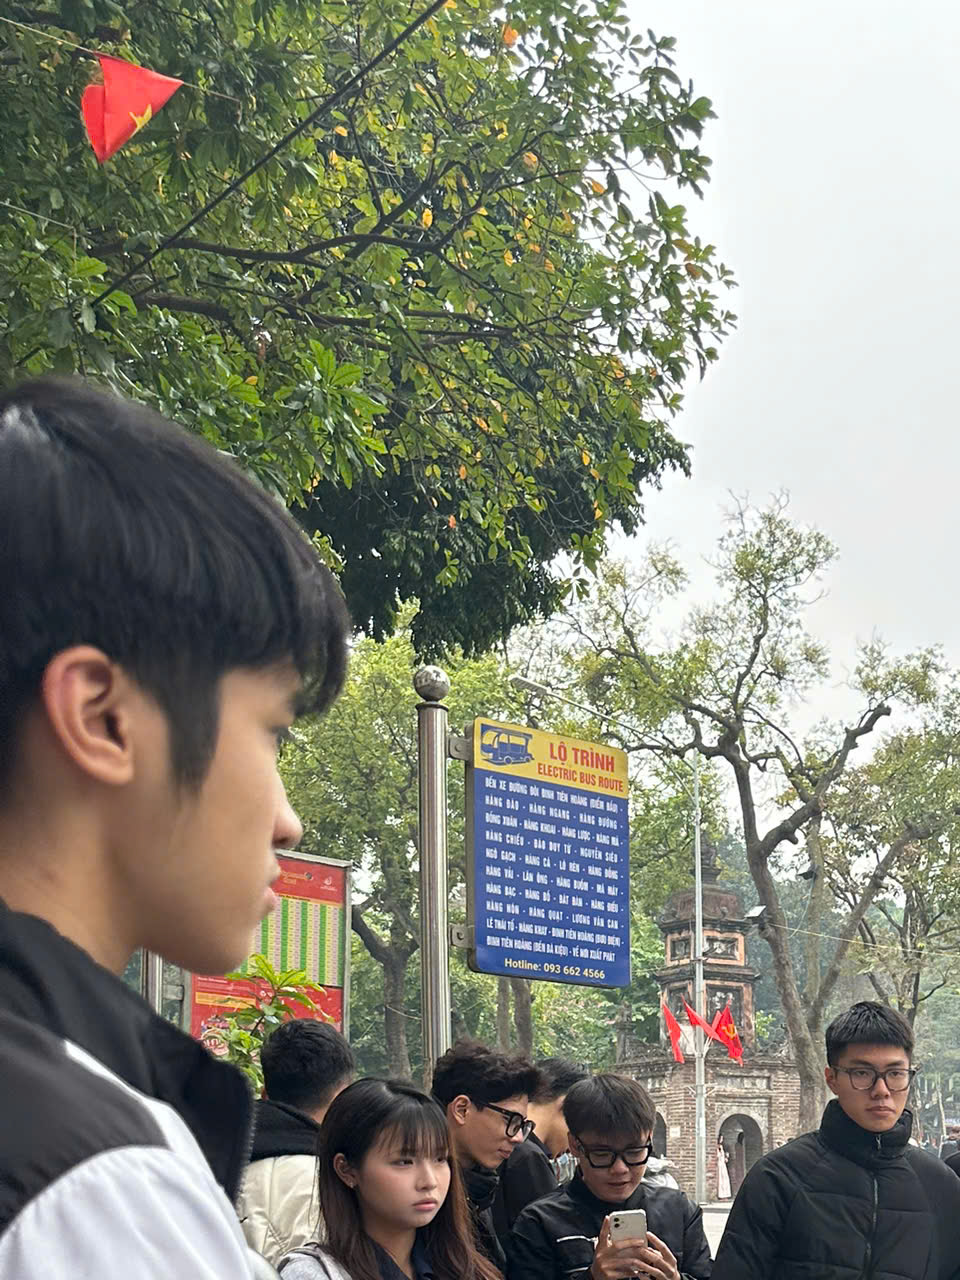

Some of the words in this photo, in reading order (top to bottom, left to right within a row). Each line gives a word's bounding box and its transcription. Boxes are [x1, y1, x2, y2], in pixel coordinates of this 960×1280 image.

[549, 741, 568, 766] LỘ
[571, 747, 615, 773] TRÌNH
[499, 780, 507, 791] XE
[537, 762, 578, 782] ELECTRIC
[579, 771, 597, 786] BUS
[598, 775, 624, 793] ROUTE
[549, 807, 570, 820] NGANG
[504, 958, 541, 971] Hotline:
[543, 962, 561, 974] 093
[563, 965, 581, 977] 662
[582, 968, 606, 979] 4566
